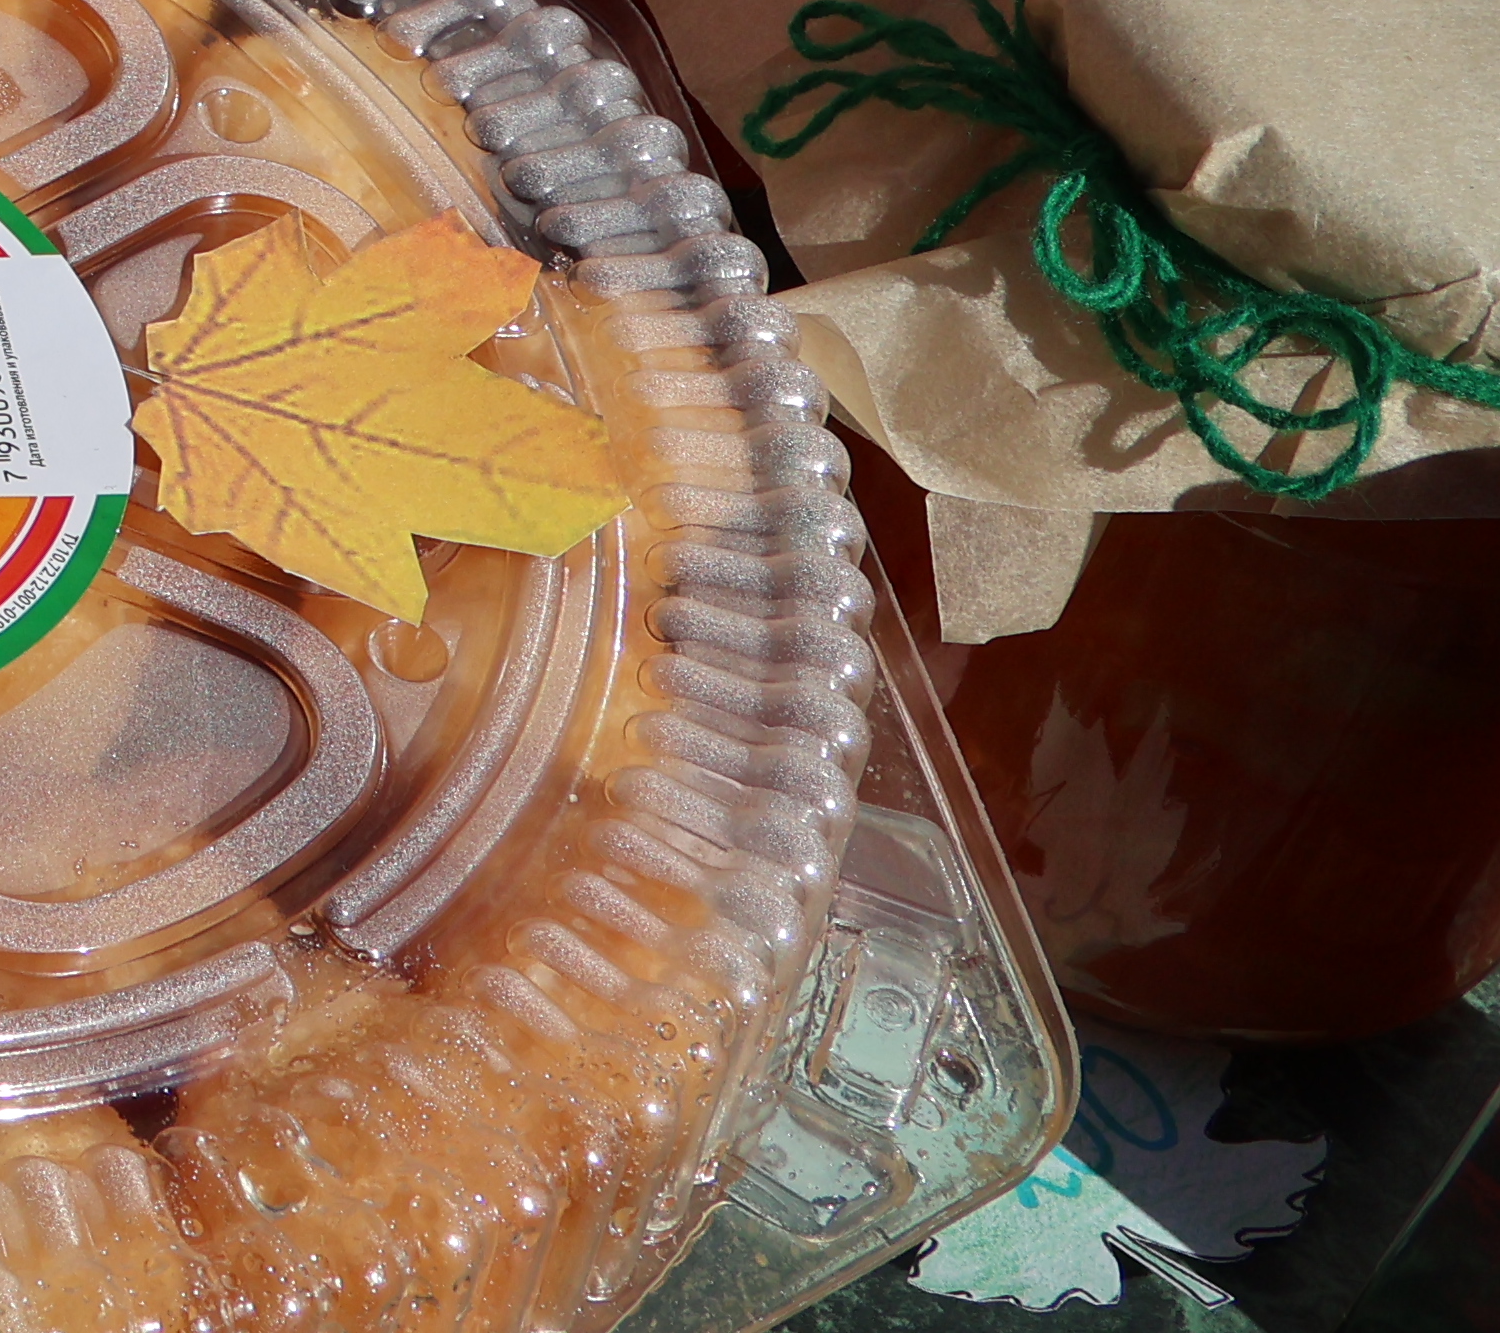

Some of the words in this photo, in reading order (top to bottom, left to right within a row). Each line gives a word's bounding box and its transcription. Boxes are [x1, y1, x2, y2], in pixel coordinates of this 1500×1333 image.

[8, 370, 40, 442] изготовления
[29, 441, 47, 468] Дата
[2, 469, 28, 483] 7
[61, 532, 79, 551] ТУ
